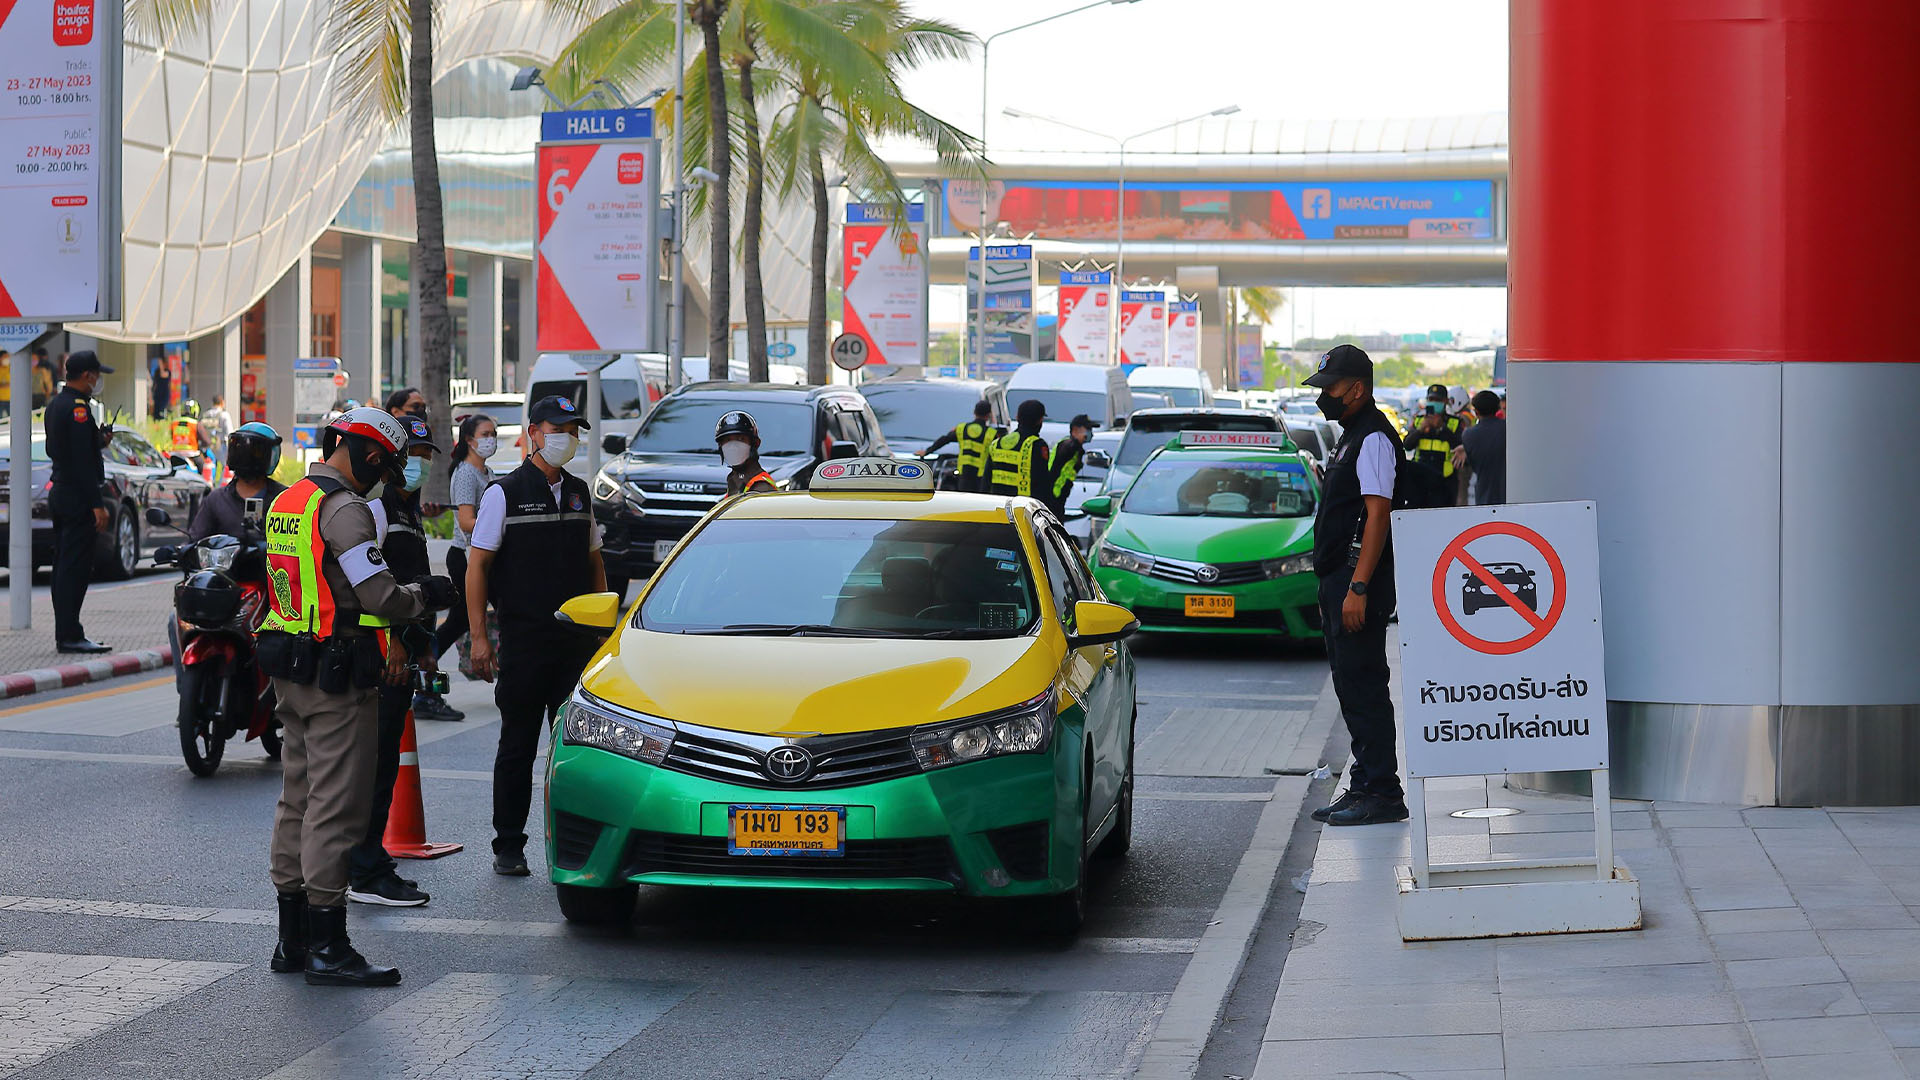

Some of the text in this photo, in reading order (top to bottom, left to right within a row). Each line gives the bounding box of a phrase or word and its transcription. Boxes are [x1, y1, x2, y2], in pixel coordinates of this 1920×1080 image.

[57, 5, 90, 16] thaifex
[57, 16, 89, 27] anuga
[63, 28, 83, 36] ASIA
[7, 79, 19, 91] 23
[29, 77, 41, 89] 27
[43, 77, 64, 91] May
[67, 75, 91, 87] 2023
[18, 94, 42, 106] 10.00
[51, 93, 74, 104] 18.00
[76, 92, 92, 103] hrs.
[567, 116, 626, 134] HALL 6
[27, 144, 91, 160] 27 May 2023
[16, 163, 40, 174] 10.00
[74, 161, 89, 172] hrs.
[546, 168, 573, 215] 6
[1337, 196, 1433, 211] IMPACTVenue
[1425, 222, 1473, 234] IMPACT
[851, 241, 868, 272] 5
[837, 340, 863, 355] 40
[379, 421, 401, 445] 6614
[1193, 434, 1271, 444] TAXI METER
[825, 463, 918, 476] APP TAXI GPS
[664, 482, 704, 493] ISUZU
[268, 517, 300, 535] POLICE
[1209, 598, 1233, 608] 3130
[1420, 673, 1588, 704] ห้ามจอดรับ-ส่ง
[1423, 712, 1589, 743] บริเวณไหล่ถนน
[741, 812, 829, 834] 1มข 193
